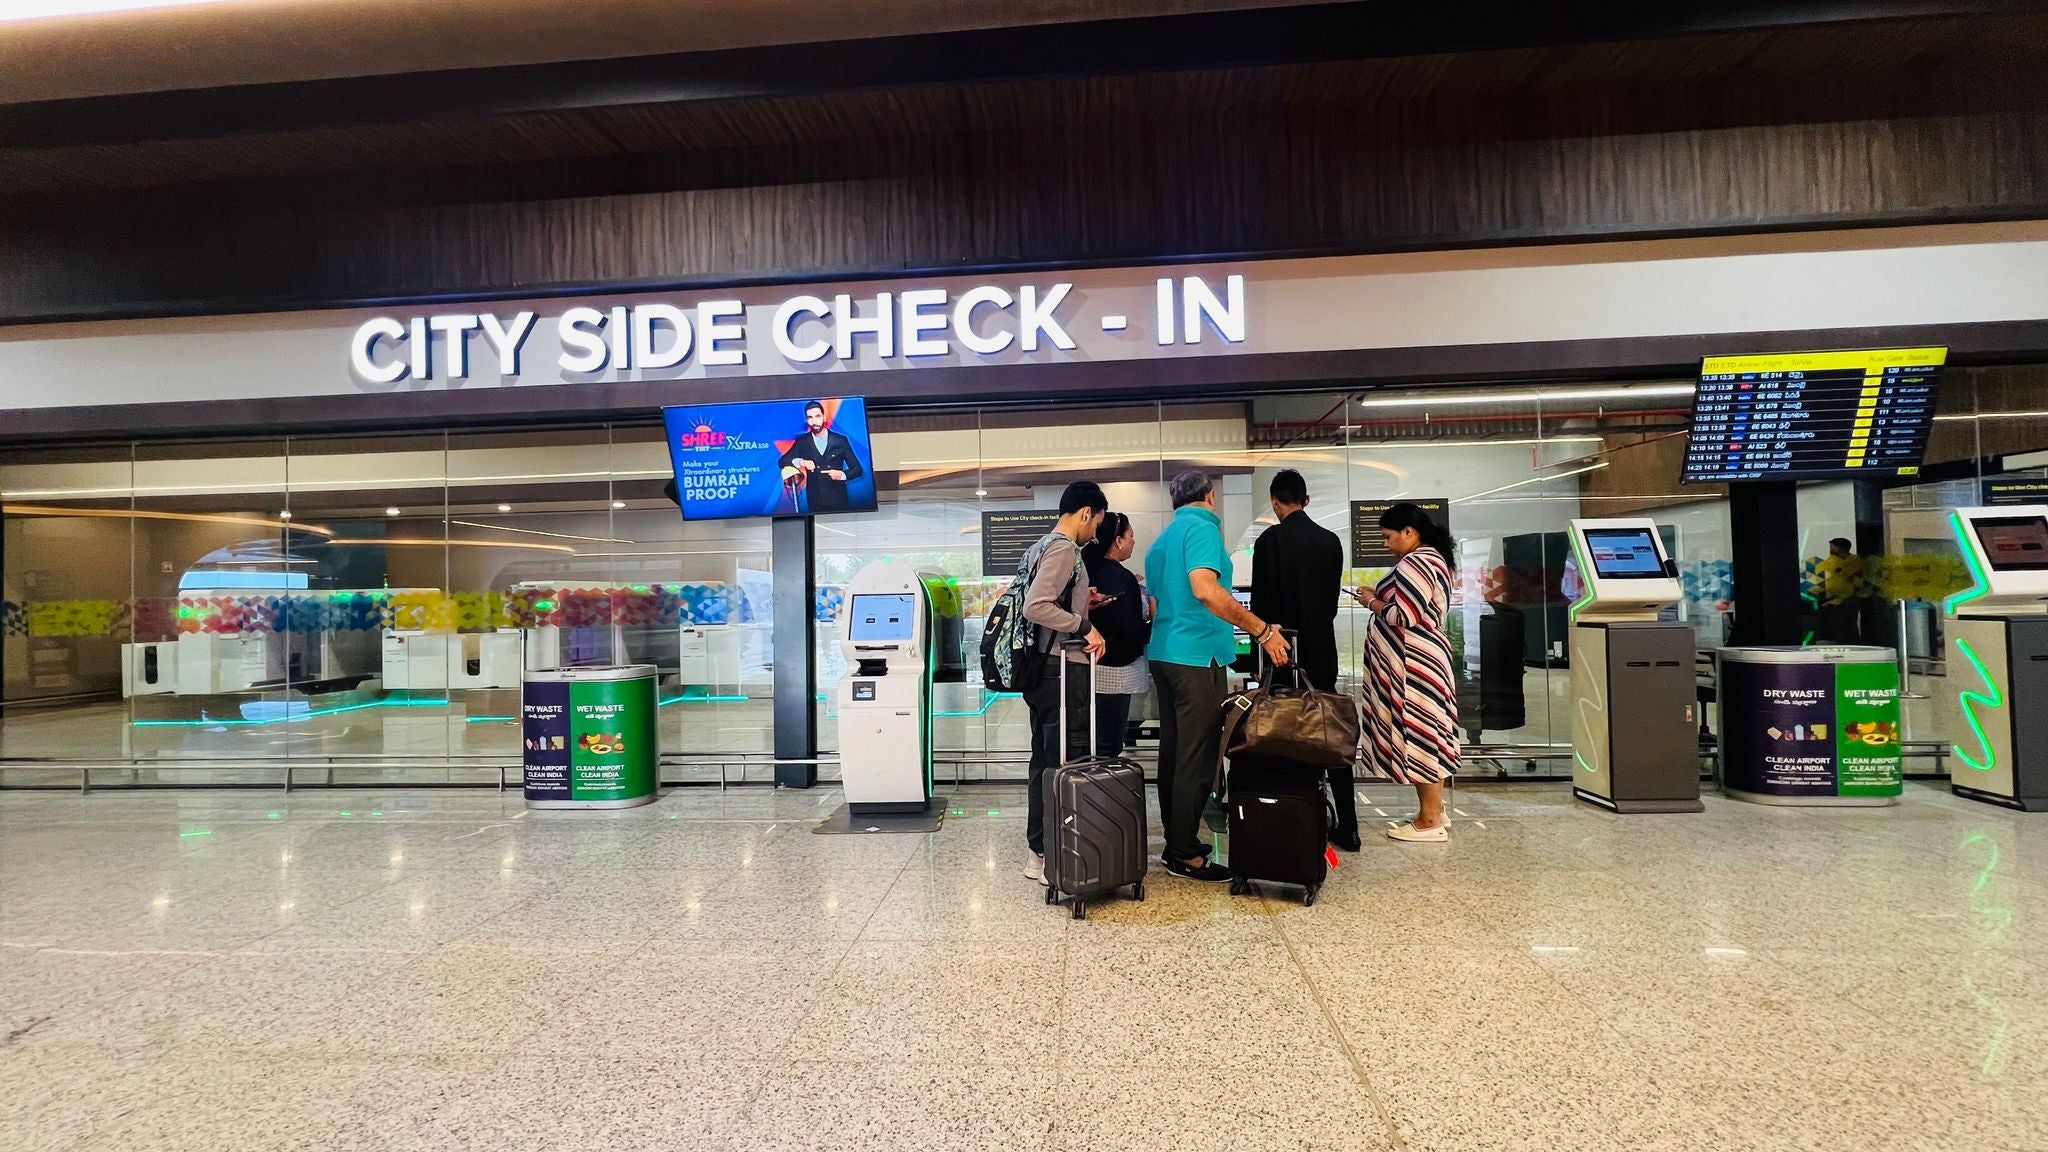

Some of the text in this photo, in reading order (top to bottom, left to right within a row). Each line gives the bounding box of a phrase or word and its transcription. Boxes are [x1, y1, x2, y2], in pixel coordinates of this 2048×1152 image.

[352, 275, 1245, 383] CITY SIDE CHECK - IN
[682, 432, 726, 447] SHREE
[683, 460, 702, 468] Make
[684, 468, 726, 476] Xtraordinary
[684, 474, 749, 488] BUMRAH
[686, 487, 737, 500] PROOF
[1764, 689, 1825, 698] DRY WASTE
[1869, 689, 1897, 697] WASTE
[595, 704, 624, 712] WASTE
[1765, 756, 1795, 764] CLEAN
